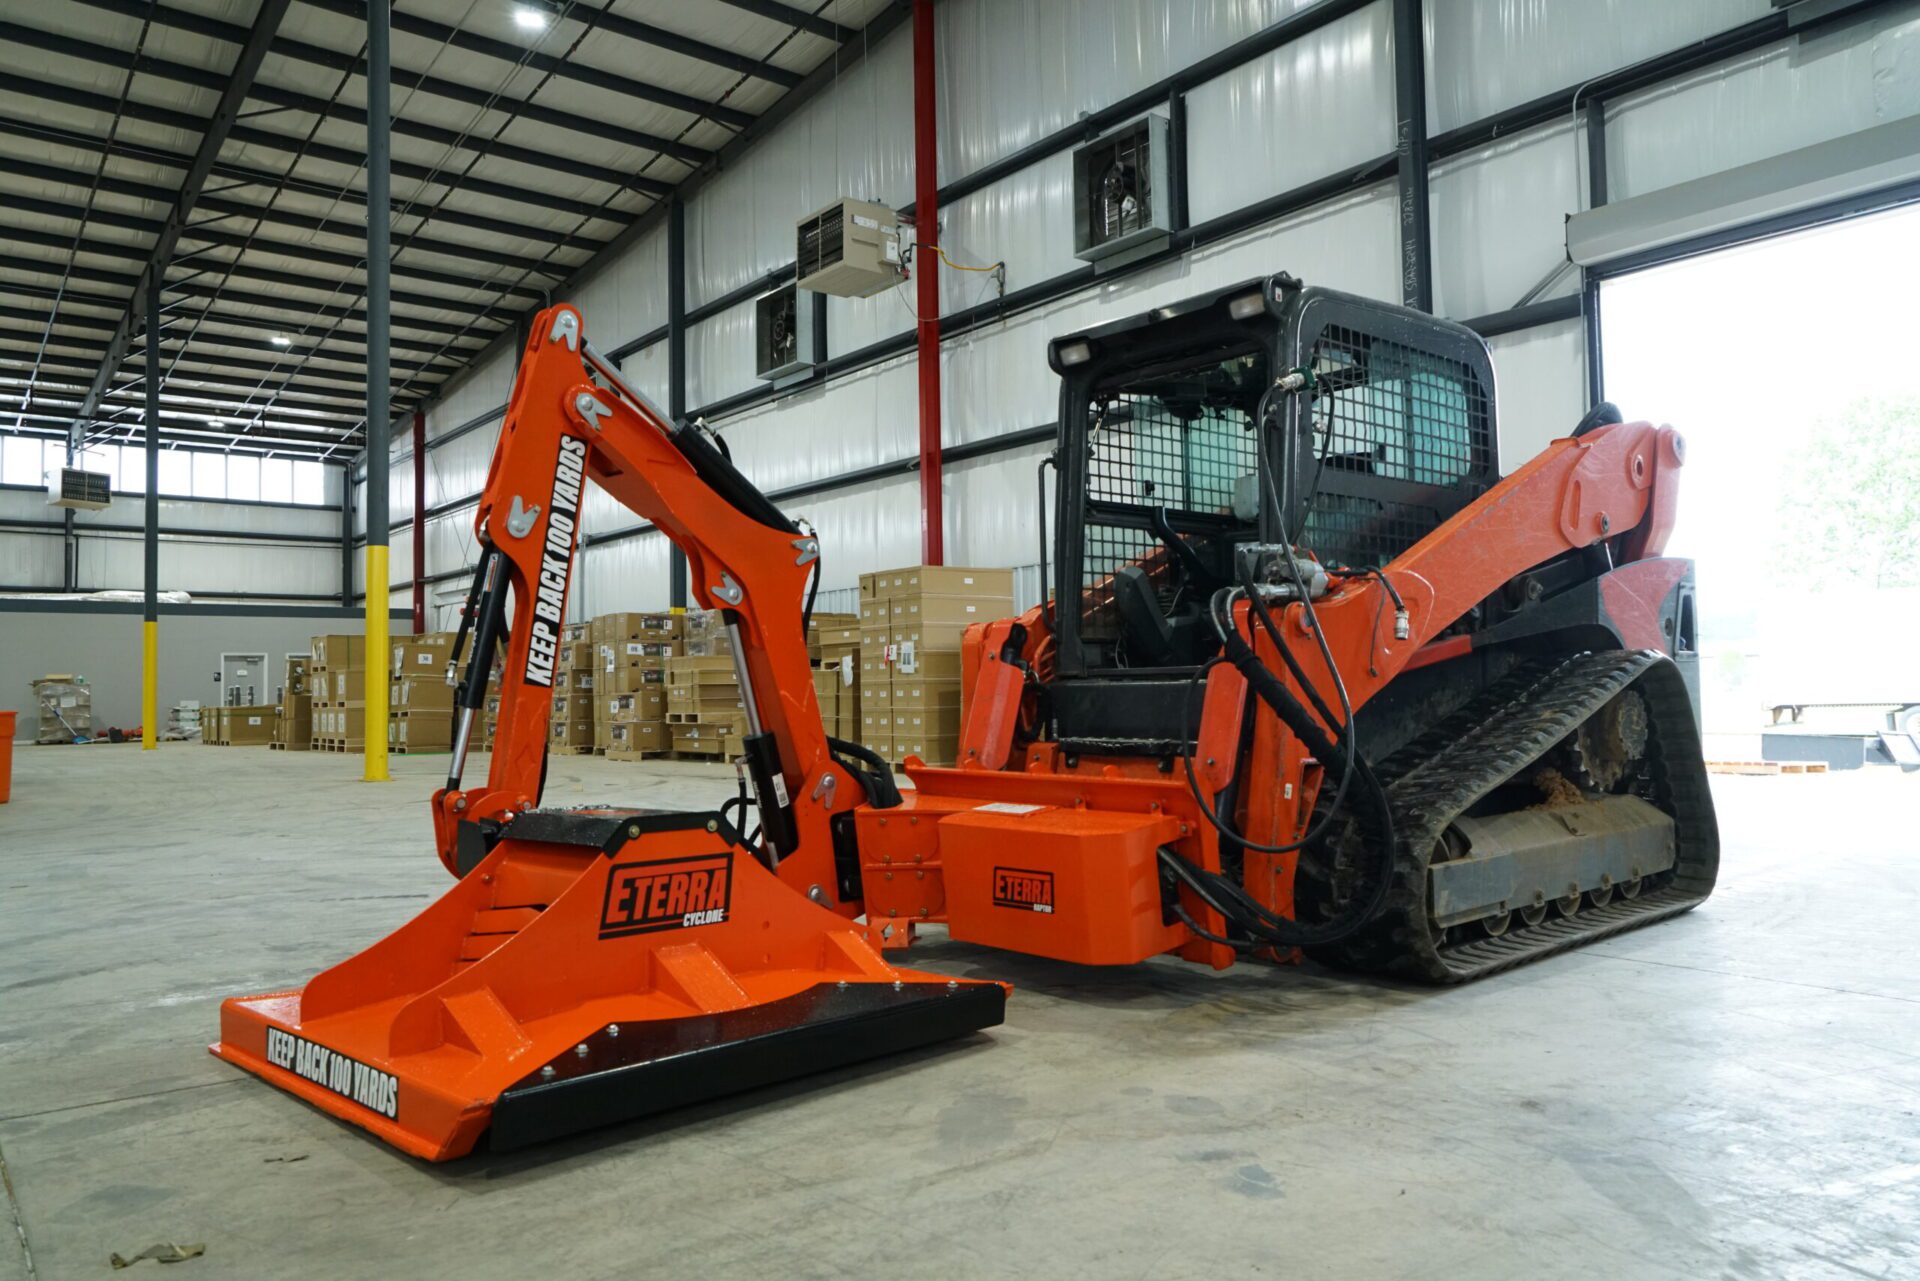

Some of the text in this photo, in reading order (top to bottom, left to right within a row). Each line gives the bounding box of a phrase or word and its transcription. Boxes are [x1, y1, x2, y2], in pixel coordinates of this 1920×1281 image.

[525, 435, 586, 686] KEEP BACK 100 YARDS
[605, 862, 728, 924] ETERRA
[682, 908, 725, 927] CYCLONE
[995, 871, 1052, 905] ETERRA
[268, 1027, 398, 1118] KEEP BACK 100 YARDS
